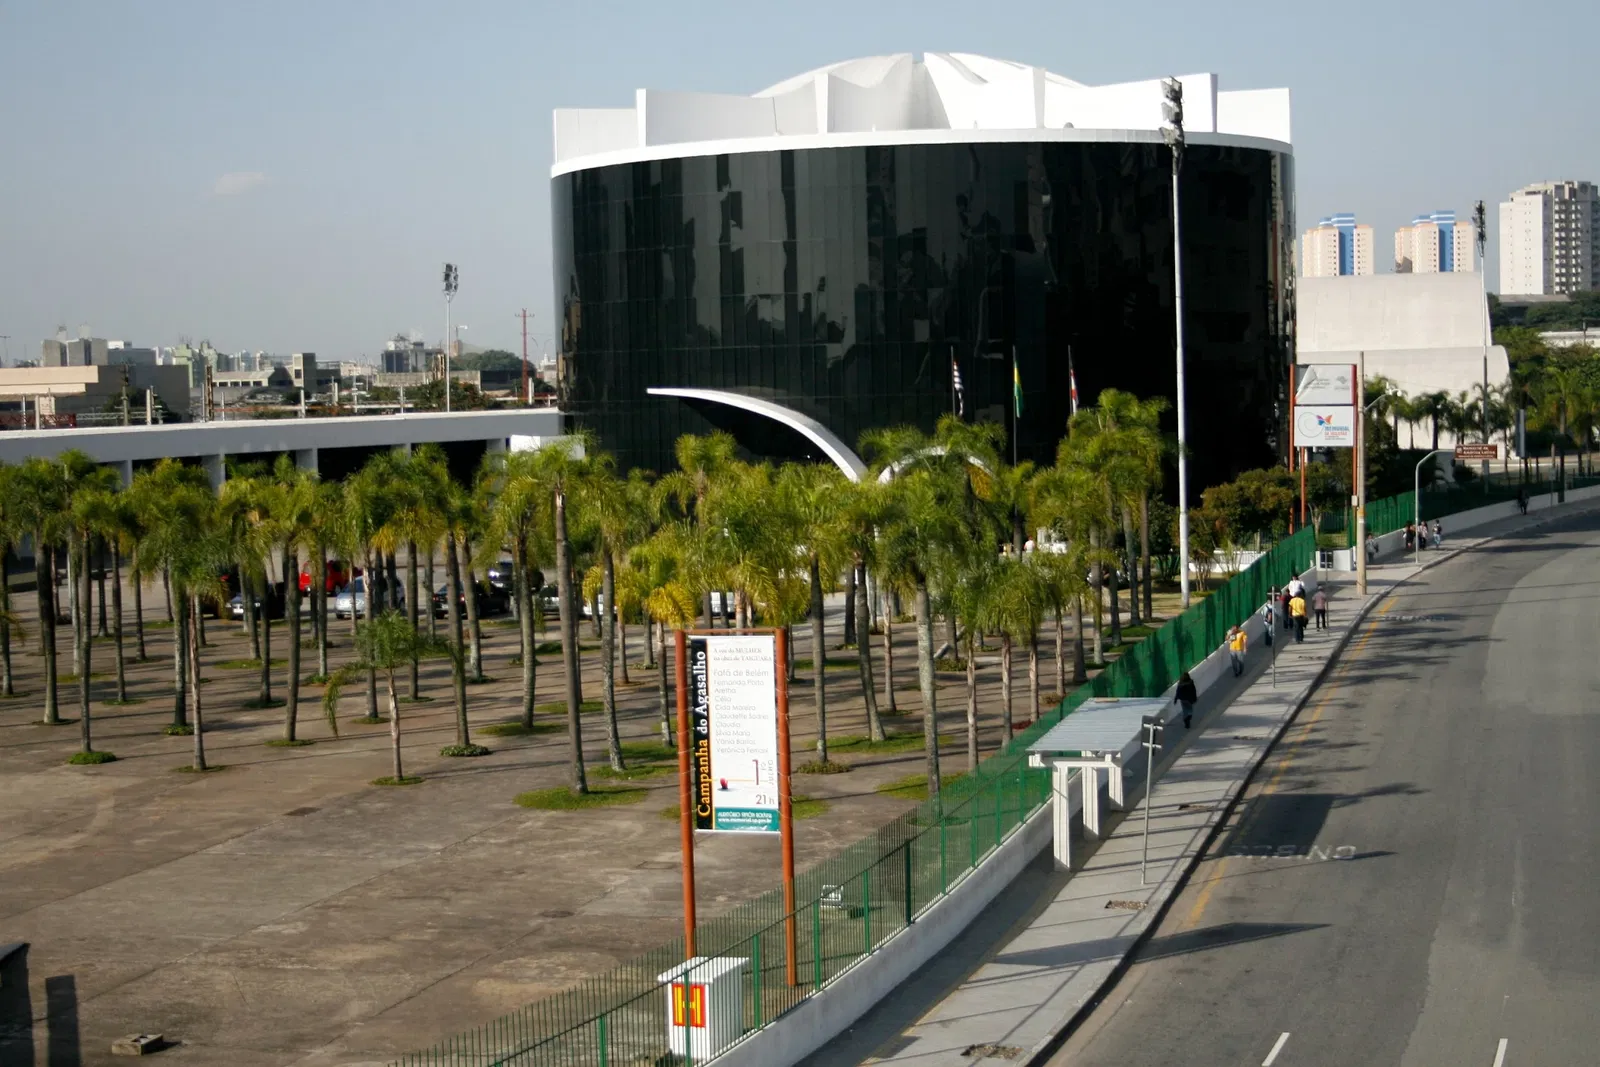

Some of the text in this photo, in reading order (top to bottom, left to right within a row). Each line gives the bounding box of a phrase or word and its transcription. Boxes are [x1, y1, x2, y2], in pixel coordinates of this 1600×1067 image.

[733, 668, 743, 676] de
[693, 651, 714, 816] Campanha do Agasalho
[752, 759, 759, 785] 1
[756, 794, 767, 804] 21
